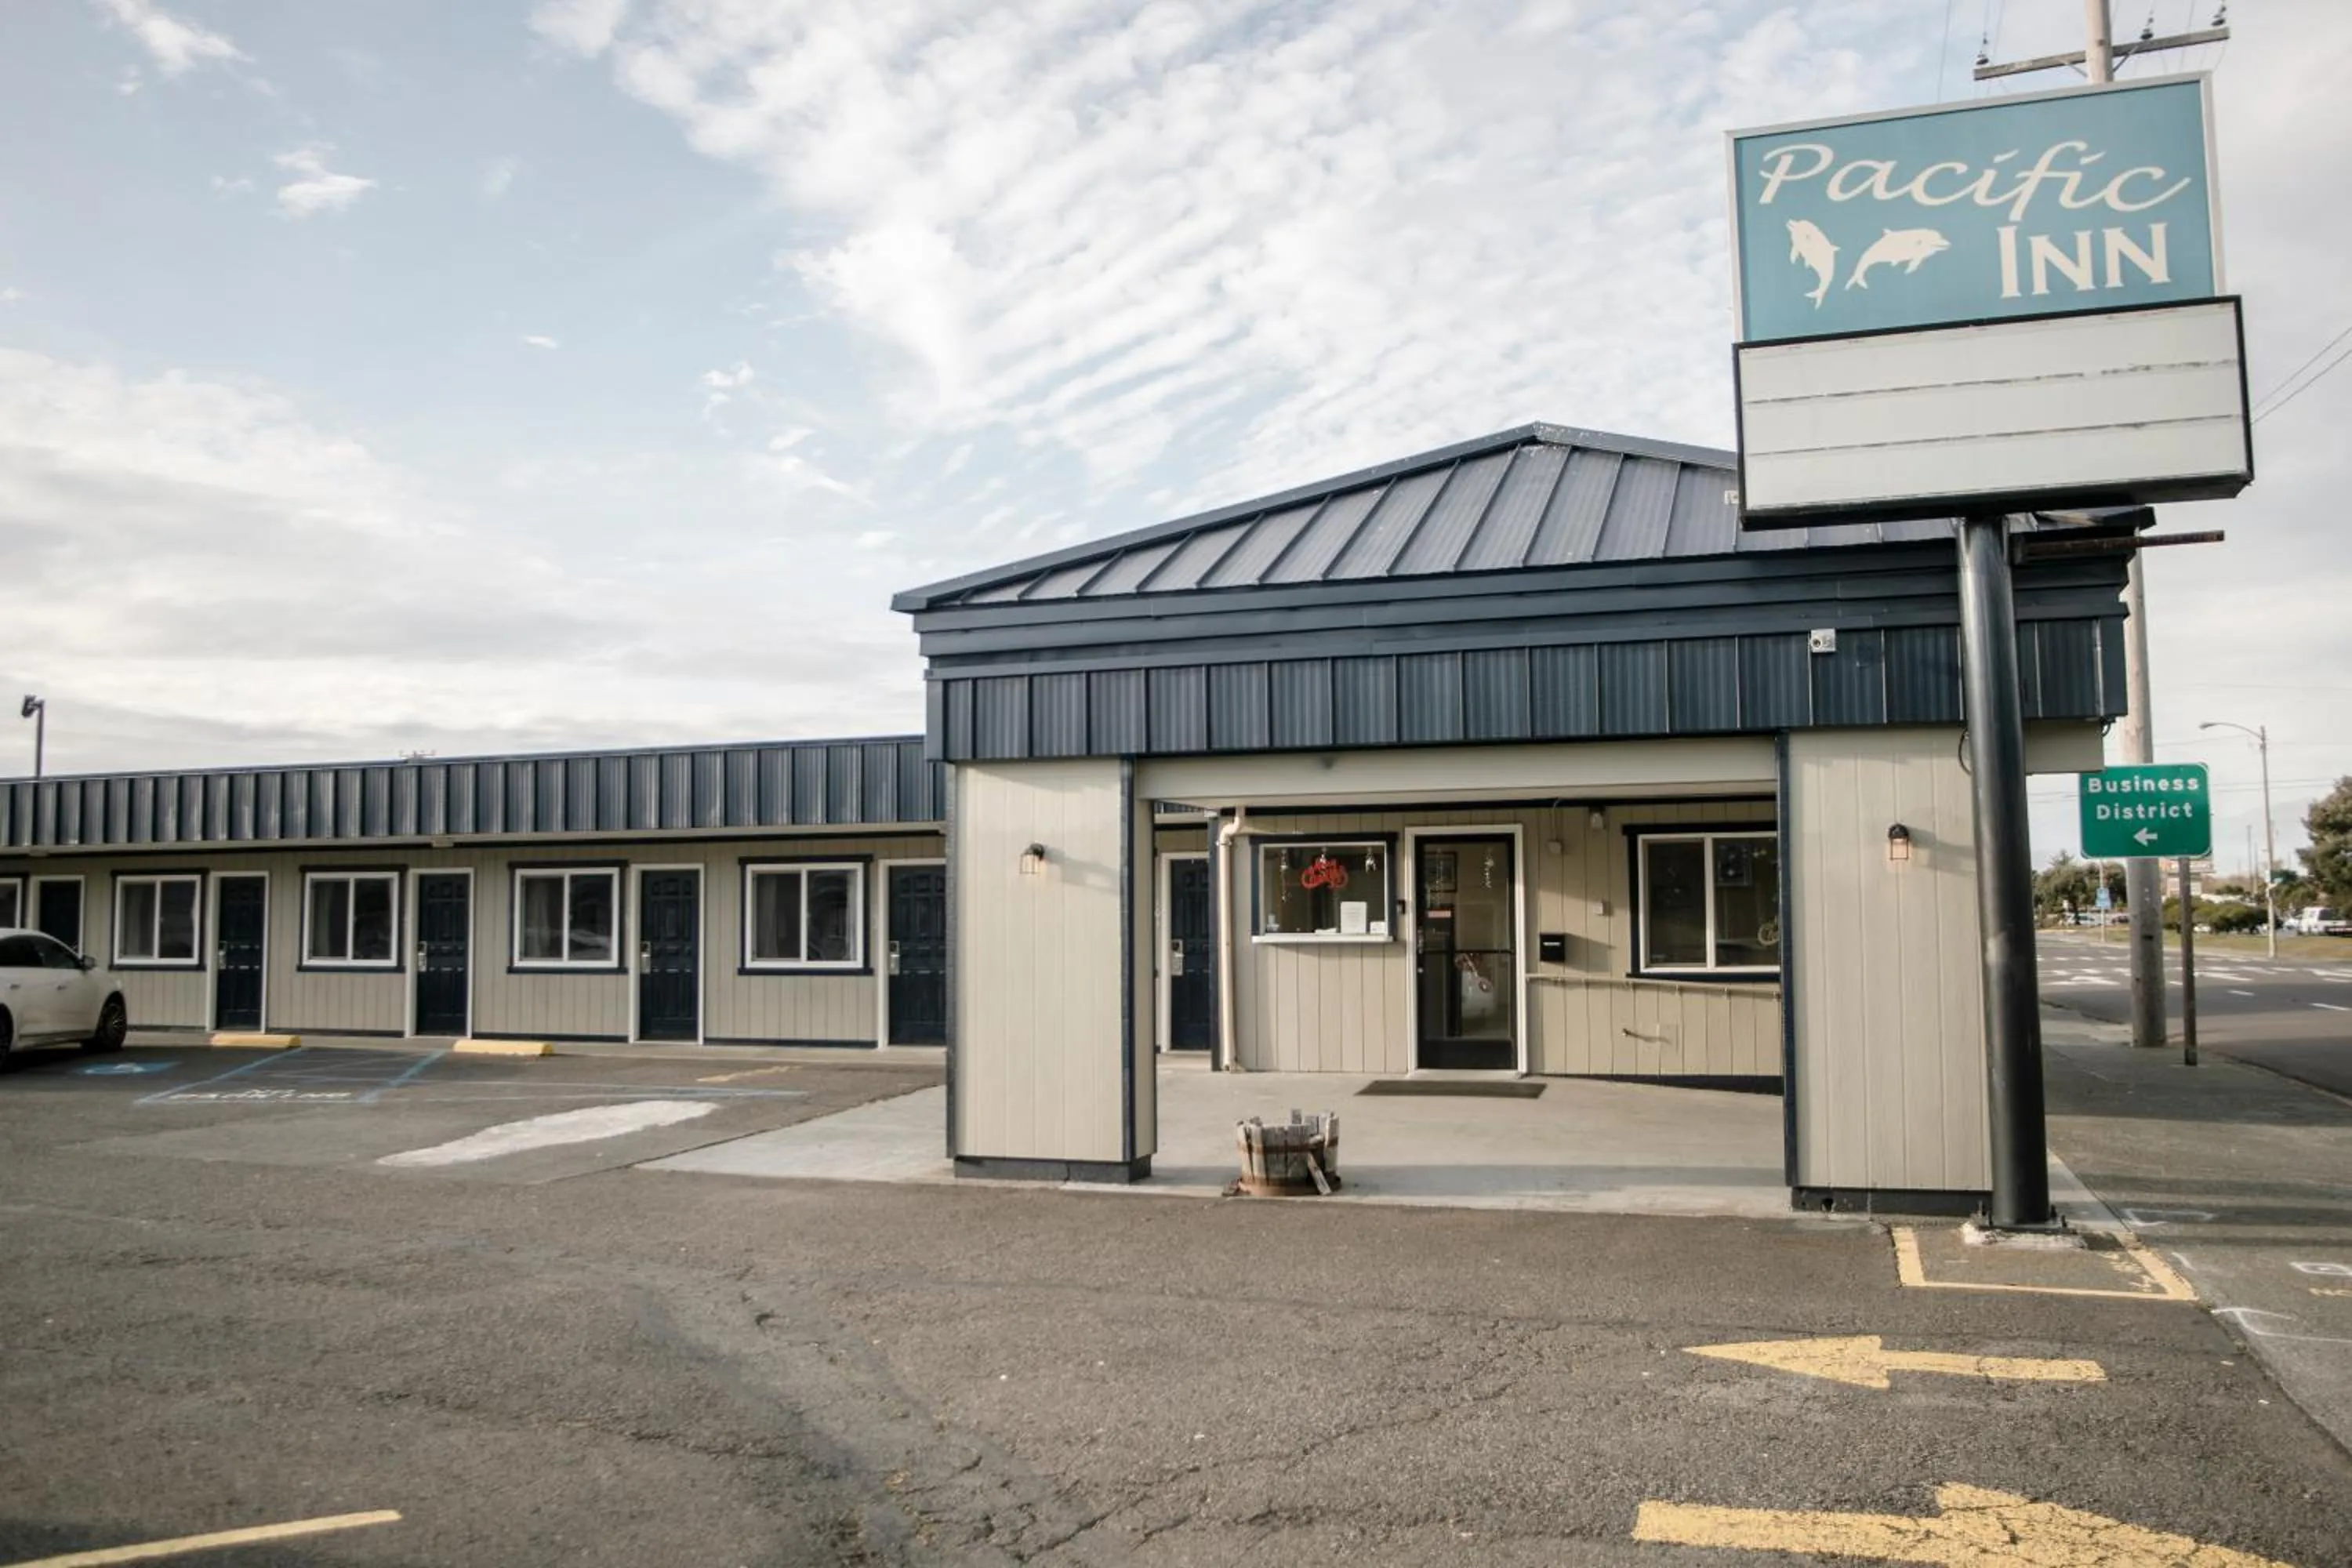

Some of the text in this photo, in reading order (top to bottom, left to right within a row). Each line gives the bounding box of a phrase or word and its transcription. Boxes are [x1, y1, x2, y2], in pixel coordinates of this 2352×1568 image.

[1759, 140, 2192, 222] Pacific
[1997, 223, 2171, 299] INN
[2088, 775, 2199, 793] Business
[2096, 802, 2194, 820] District
